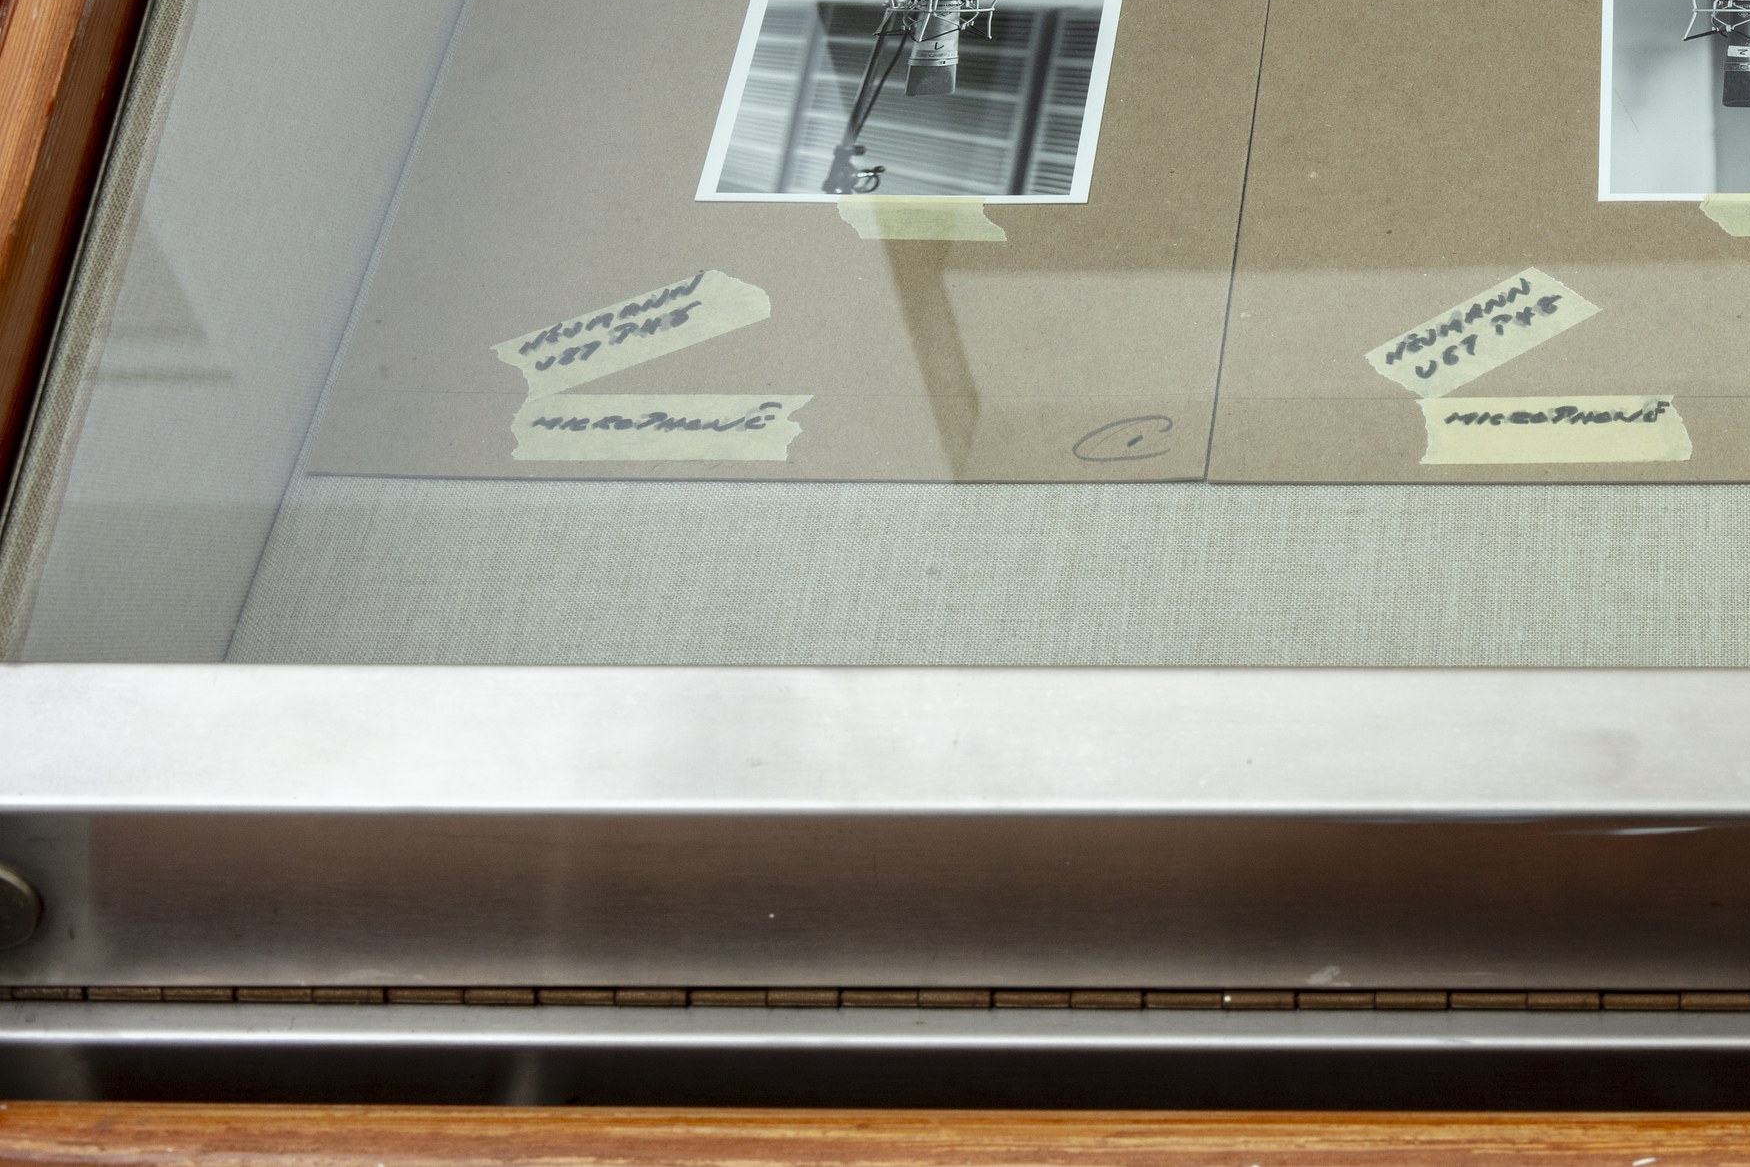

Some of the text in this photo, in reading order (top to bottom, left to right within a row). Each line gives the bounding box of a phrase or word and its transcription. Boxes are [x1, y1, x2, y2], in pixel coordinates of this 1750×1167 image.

[518, 270, 704, 355] NEUMANN
[1385, 277, 1532, 365] NEUMANN
[531, 400, 783, 432] MICROPHONE
[1444, 399, 1671, 426] MICROPHONE
